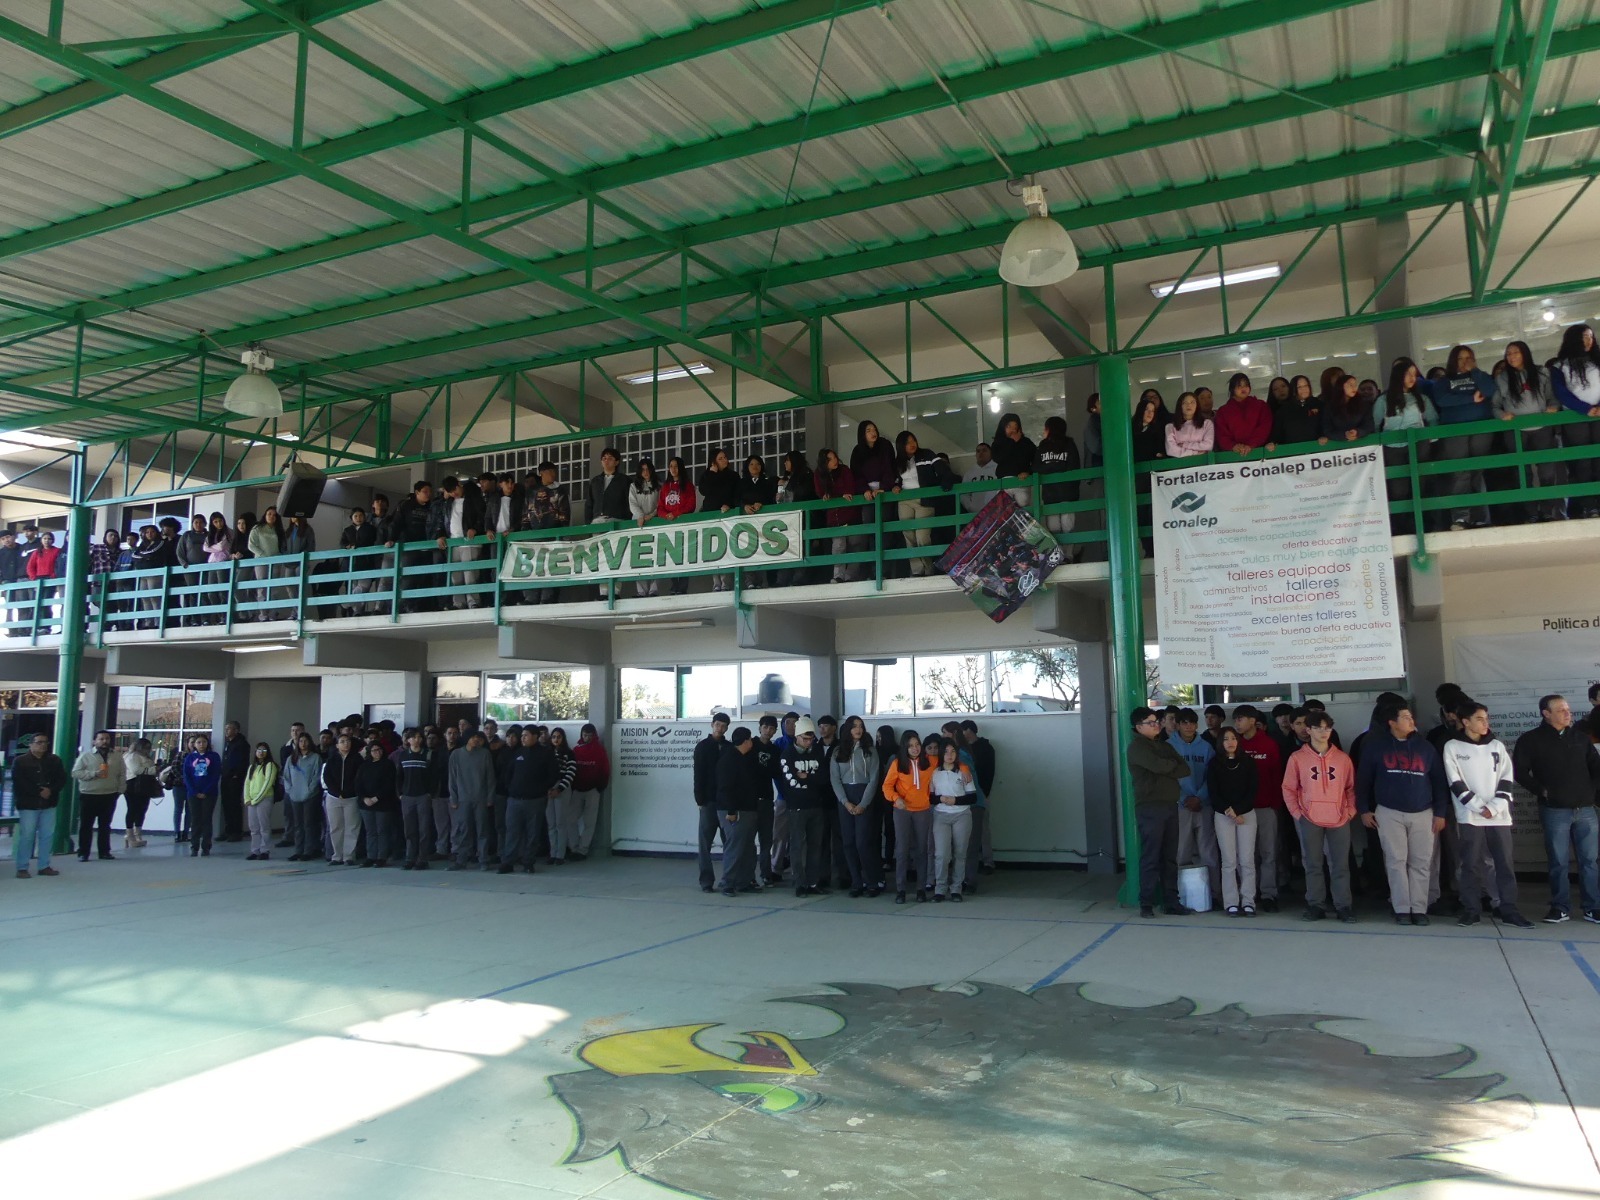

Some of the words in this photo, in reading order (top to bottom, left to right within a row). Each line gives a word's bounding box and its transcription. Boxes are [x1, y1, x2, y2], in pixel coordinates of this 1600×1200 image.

[1156, 470, 1235, 487] Fortalezas
[1240, 462, 1305, 479] Conalep
[1310, 452, 1377, 470] Delicias
[1162, 515, 1218, 529] conalep
[1217, 534, 1258, 545] docentes
[1260, 528, 1317, 543] capacitados
[1282, 539, 1309, 550] oferta
[1311, 536, 1358, 547] educativa
[512, 519, 790, 579] BIENVENIDOS
[1241, 553, 1270, 565] aulas
[1273, 551, 1297, 562] muy
[1300, 548, 1324, 560] bien
[1327, 543, 1388, 559] equipadas
[1227, 569, 1274, 582] talleres
[1277, 561, 1351, 578] equipados
[1203, 584, 1268, 597] administrativos
[1286, 577, 1340, 591] talleres
[1360, 558, 1374, 610] docentes
[1377, 561, 1390, 617] compromiso
[1250, 589, 1340, 606] instalaciones
[1250, 612, 1313, 625] excelentes
[1316, 609, 1357, 621] talleres
[1281, 626, 1311, 636] buena
[1313, 624, 1341, 634] oferta
[1343, 620, 1392, 632] educativa
[1291, 634, 1353, 647] capacitación
[1241, 649, 1269, 657] equipado
[1509, 710, 1539, 722] CONAL
[674, 728, 702, 739] conalep
[1384, 752, 1425, 772] USA
